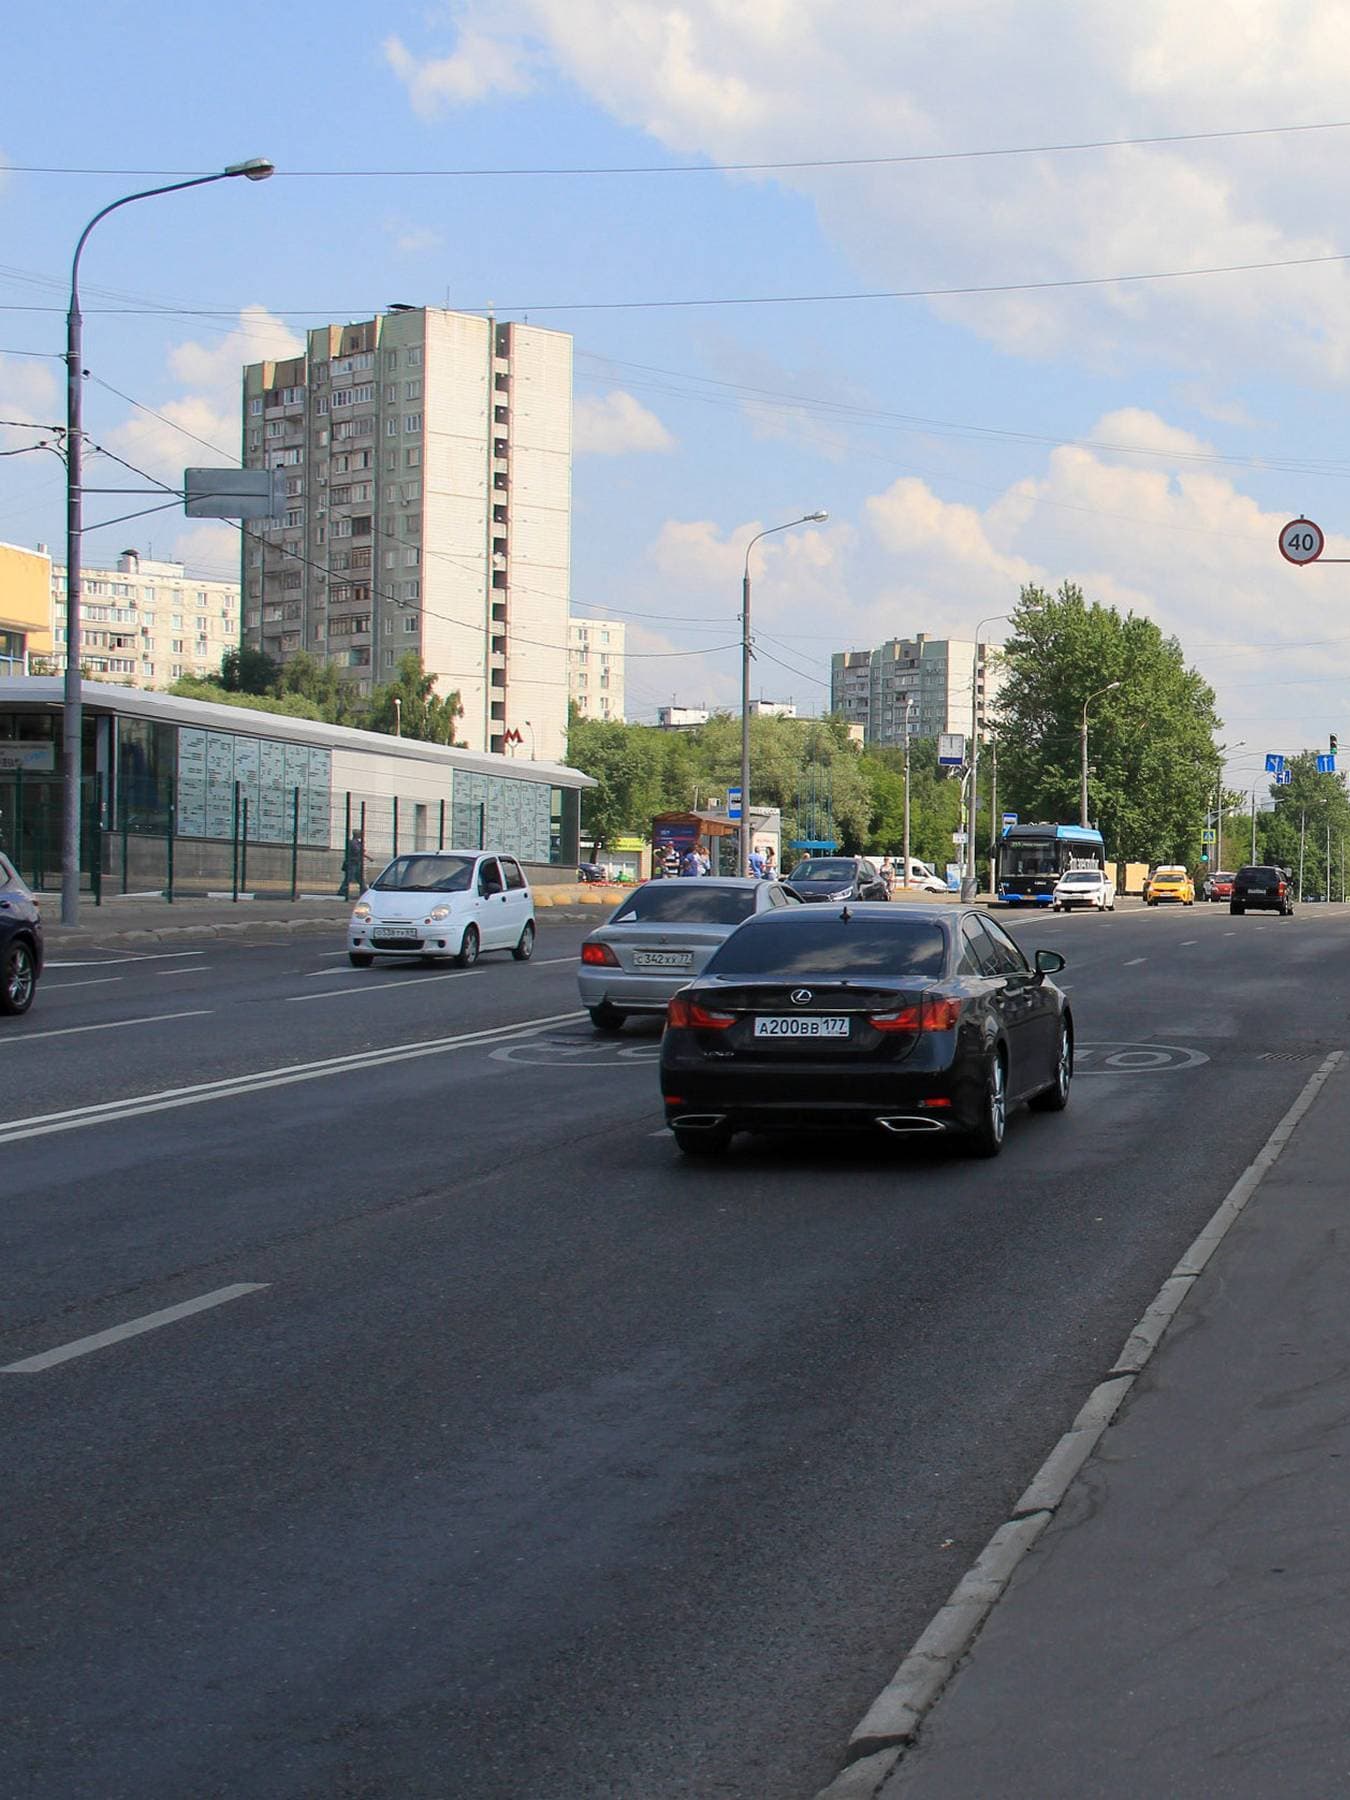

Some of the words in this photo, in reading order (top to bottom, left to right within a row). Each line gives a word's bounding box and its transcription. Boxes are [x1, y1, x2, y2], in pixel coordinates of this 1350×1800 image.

[1288, 533, 1314, 552] 40
[759, 1019, 820, 1034] А200ВВ
[823, 1018, 846, 1031] 177
